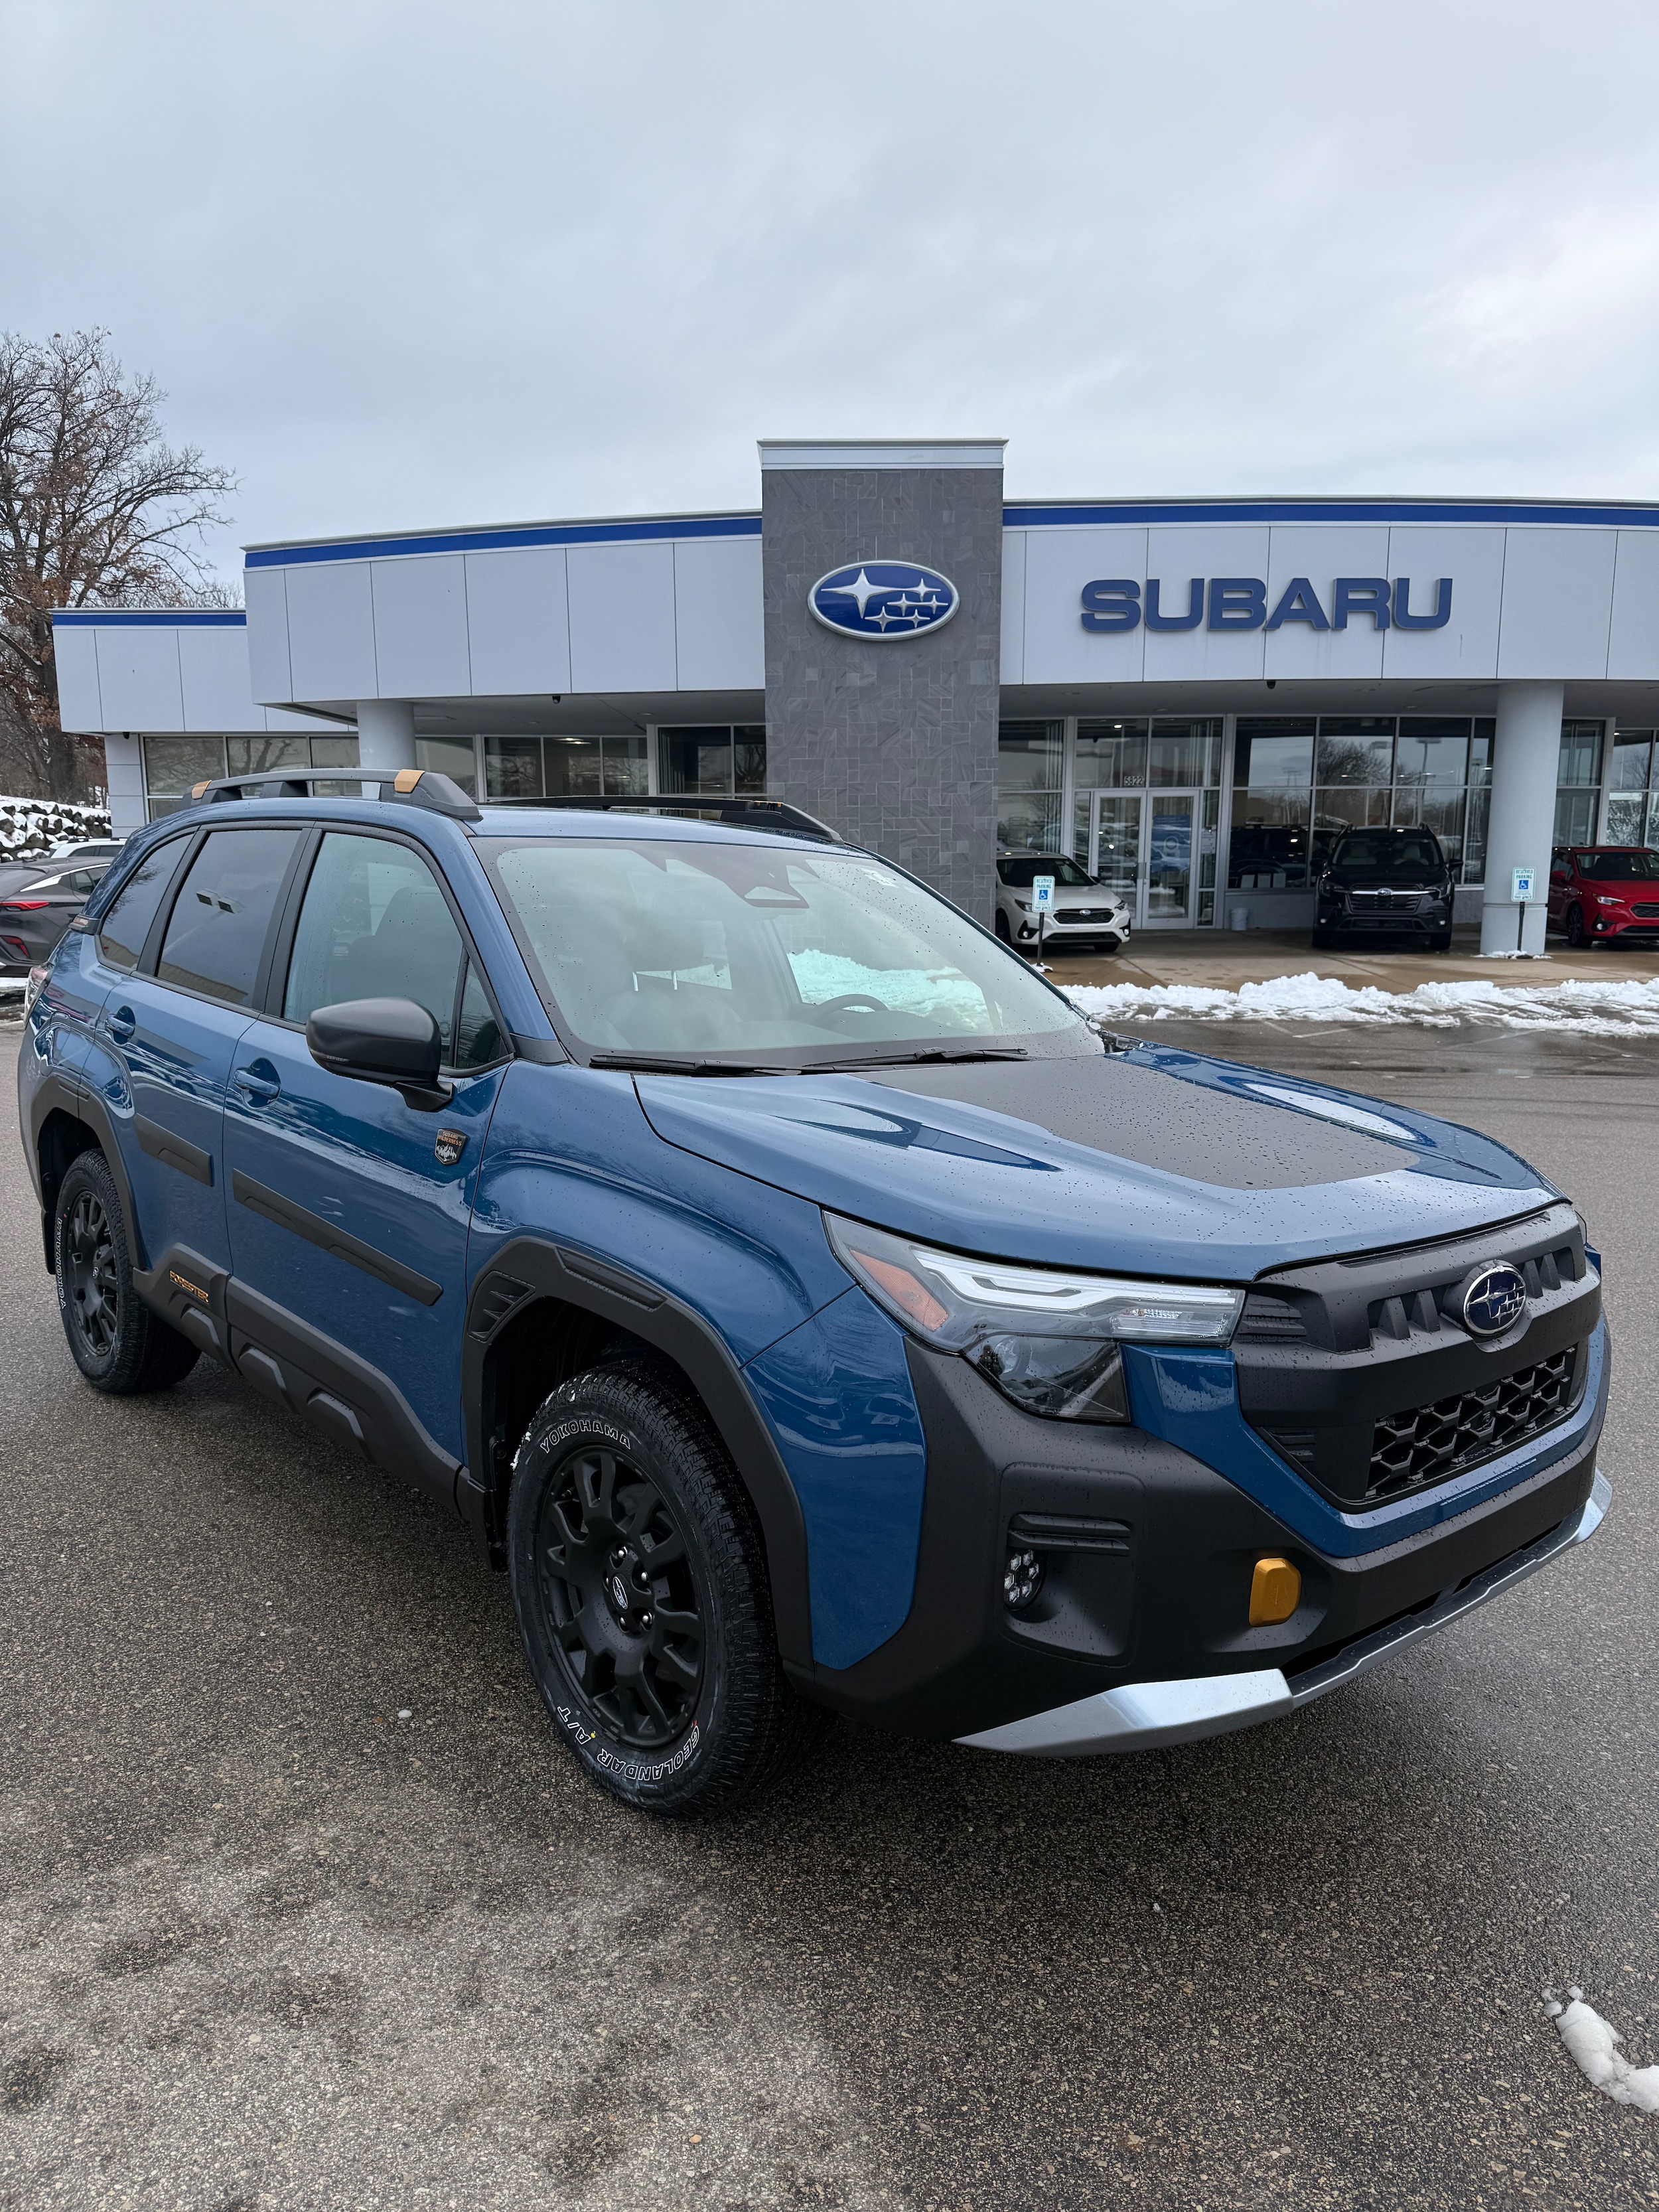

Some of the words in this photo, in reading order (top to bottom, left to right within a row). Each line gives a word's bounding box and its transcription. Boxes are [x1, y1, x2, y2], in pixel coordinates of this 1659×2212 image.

[1081, 577, 1453, 632] SUBARU
[1124, 776, 1143, 785] 5822
[437, 1135, 463, 1147] WILDERNESS
[443, 1131, 459, 1140] SUBARU
[56, 1217, 66, 1309] YOKOHAMA
[169, 1270, 209, 1303] FORESTER
[540, 1420, 631, 1454] YOKOHAMA
[557, 1706, 592, 1745] A/T
[597, 1725, 700, 1781] GEOLANDAR
